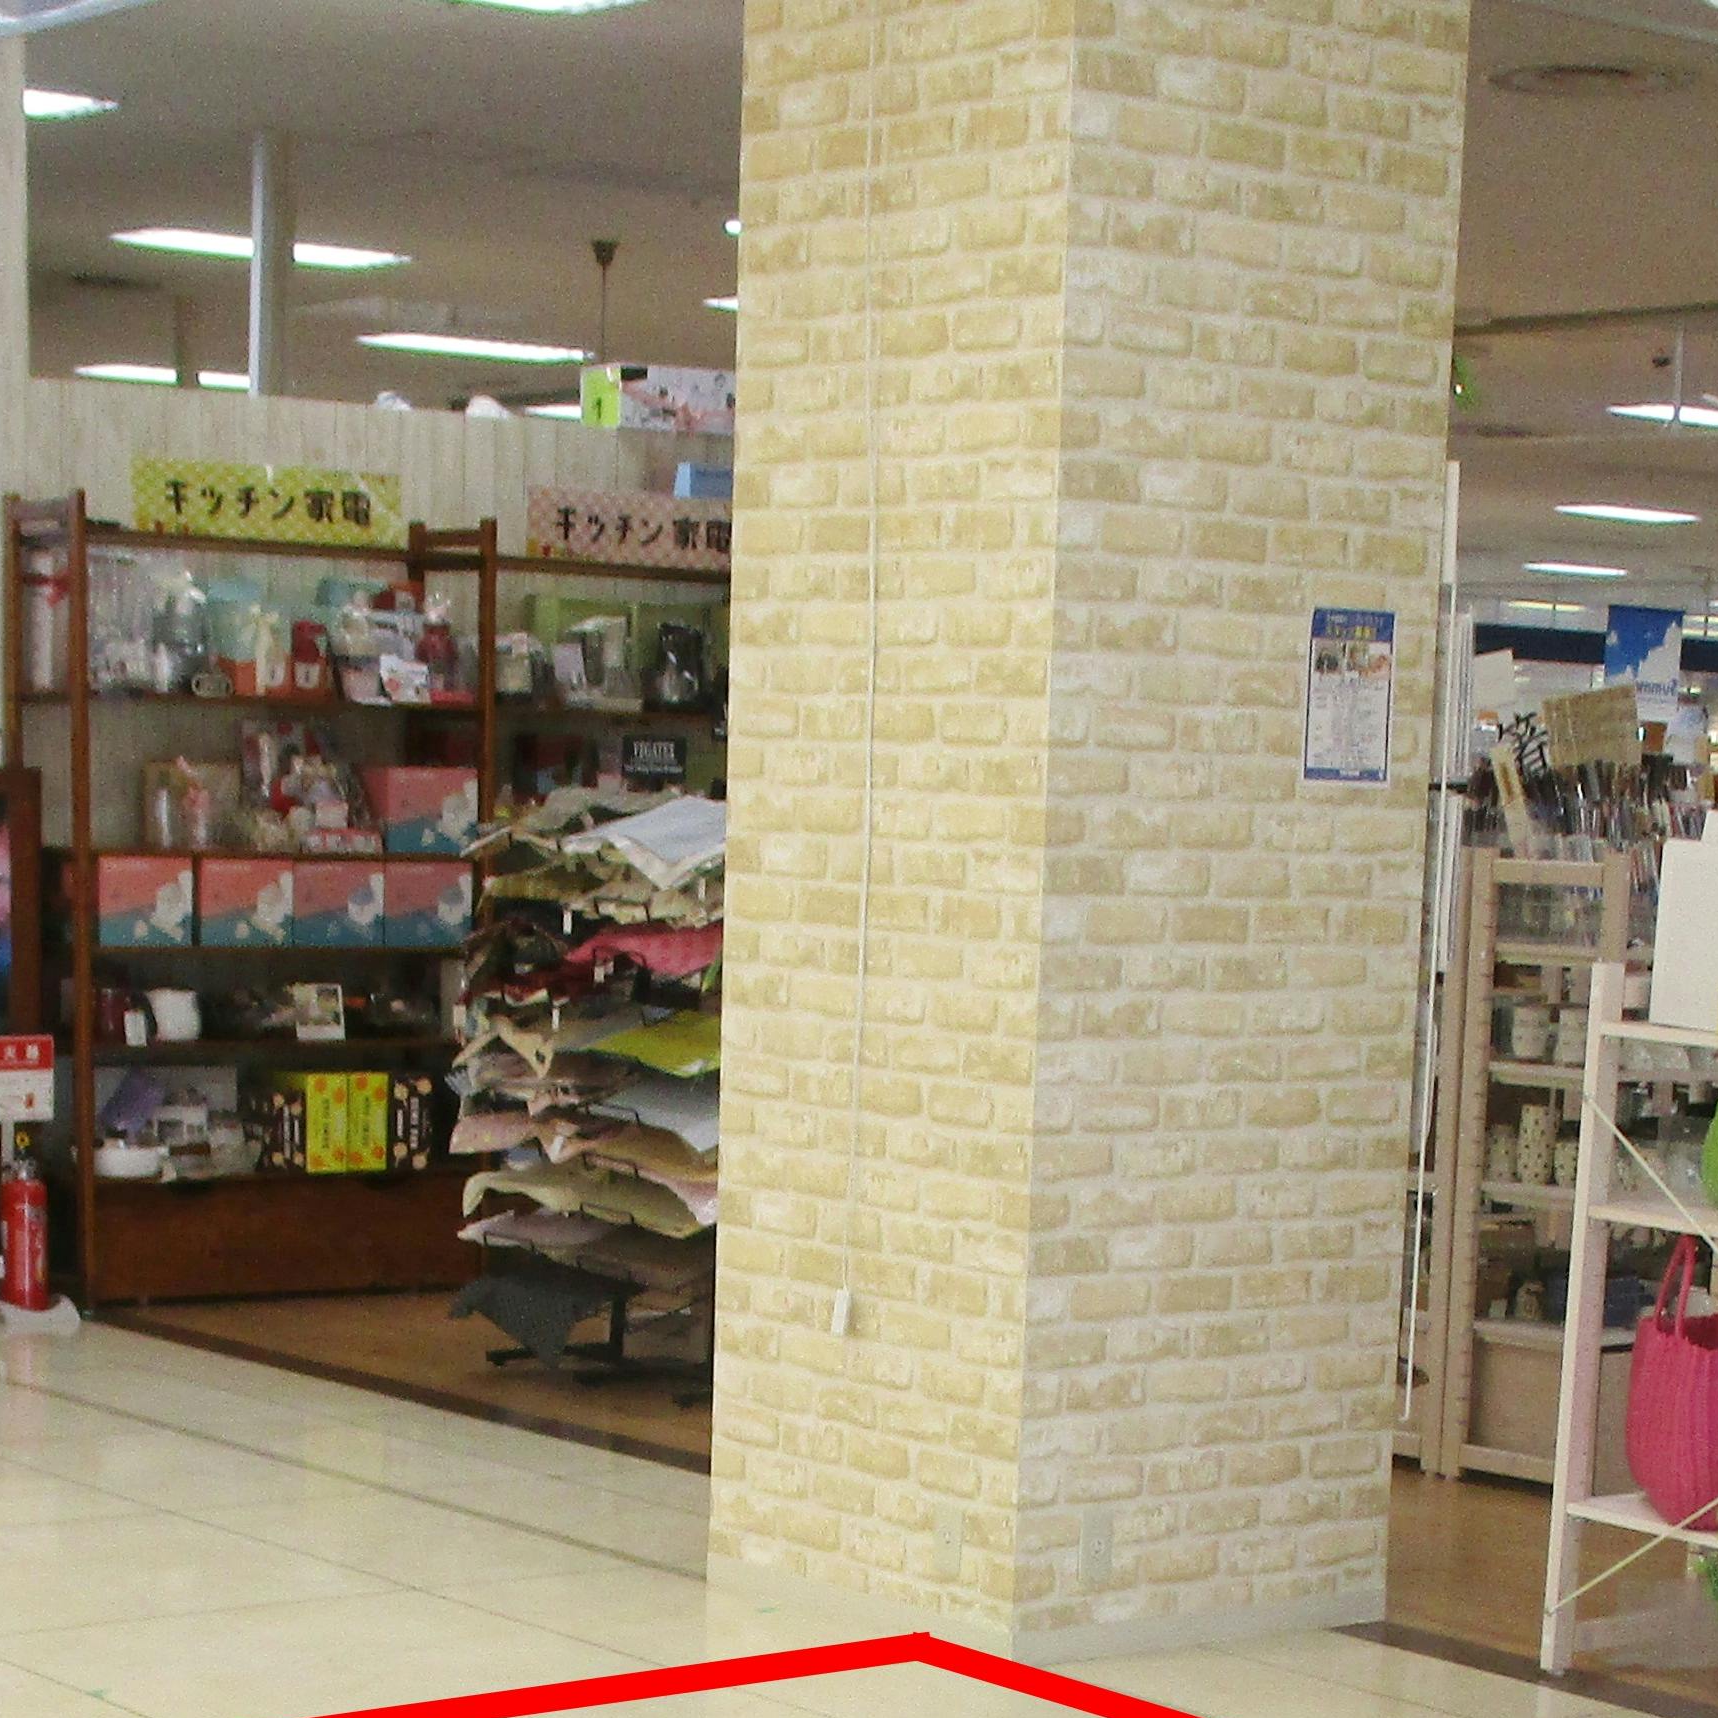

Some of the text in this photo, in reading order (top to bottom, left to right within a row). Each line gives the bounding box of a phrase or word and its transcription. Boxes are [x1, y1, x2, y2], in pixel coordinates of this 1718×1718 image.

[163, 478, 372, 528] キッチン家電
